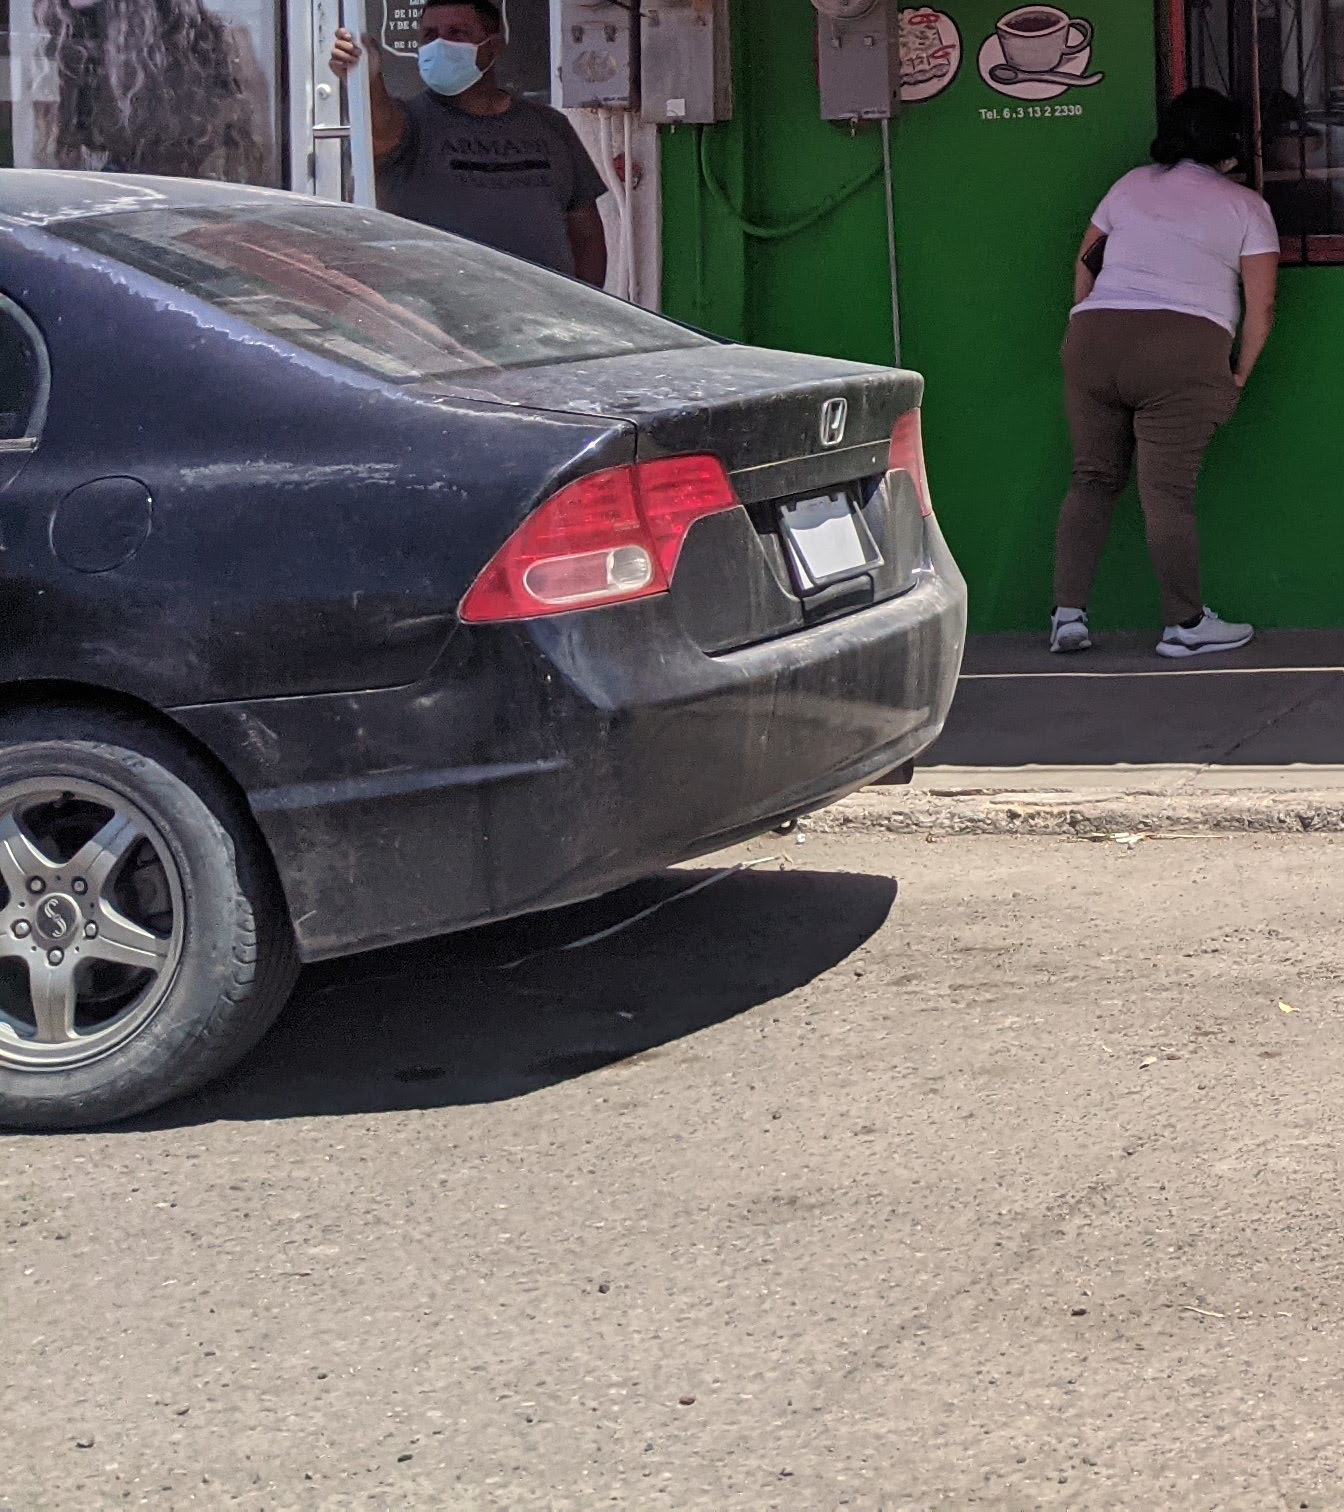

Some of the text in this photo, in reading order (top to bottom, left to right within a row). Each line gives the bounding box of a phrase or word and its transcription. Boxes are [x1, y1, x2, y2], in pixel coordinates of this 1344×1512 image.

[394, 9, 406, 18] DE
[397, 21, 409, 30] DE
[1027, 107, 1041, 117] 13
[1044, 106, 1051, 117] 2
[1054, 105, 1083, 116] 2330
